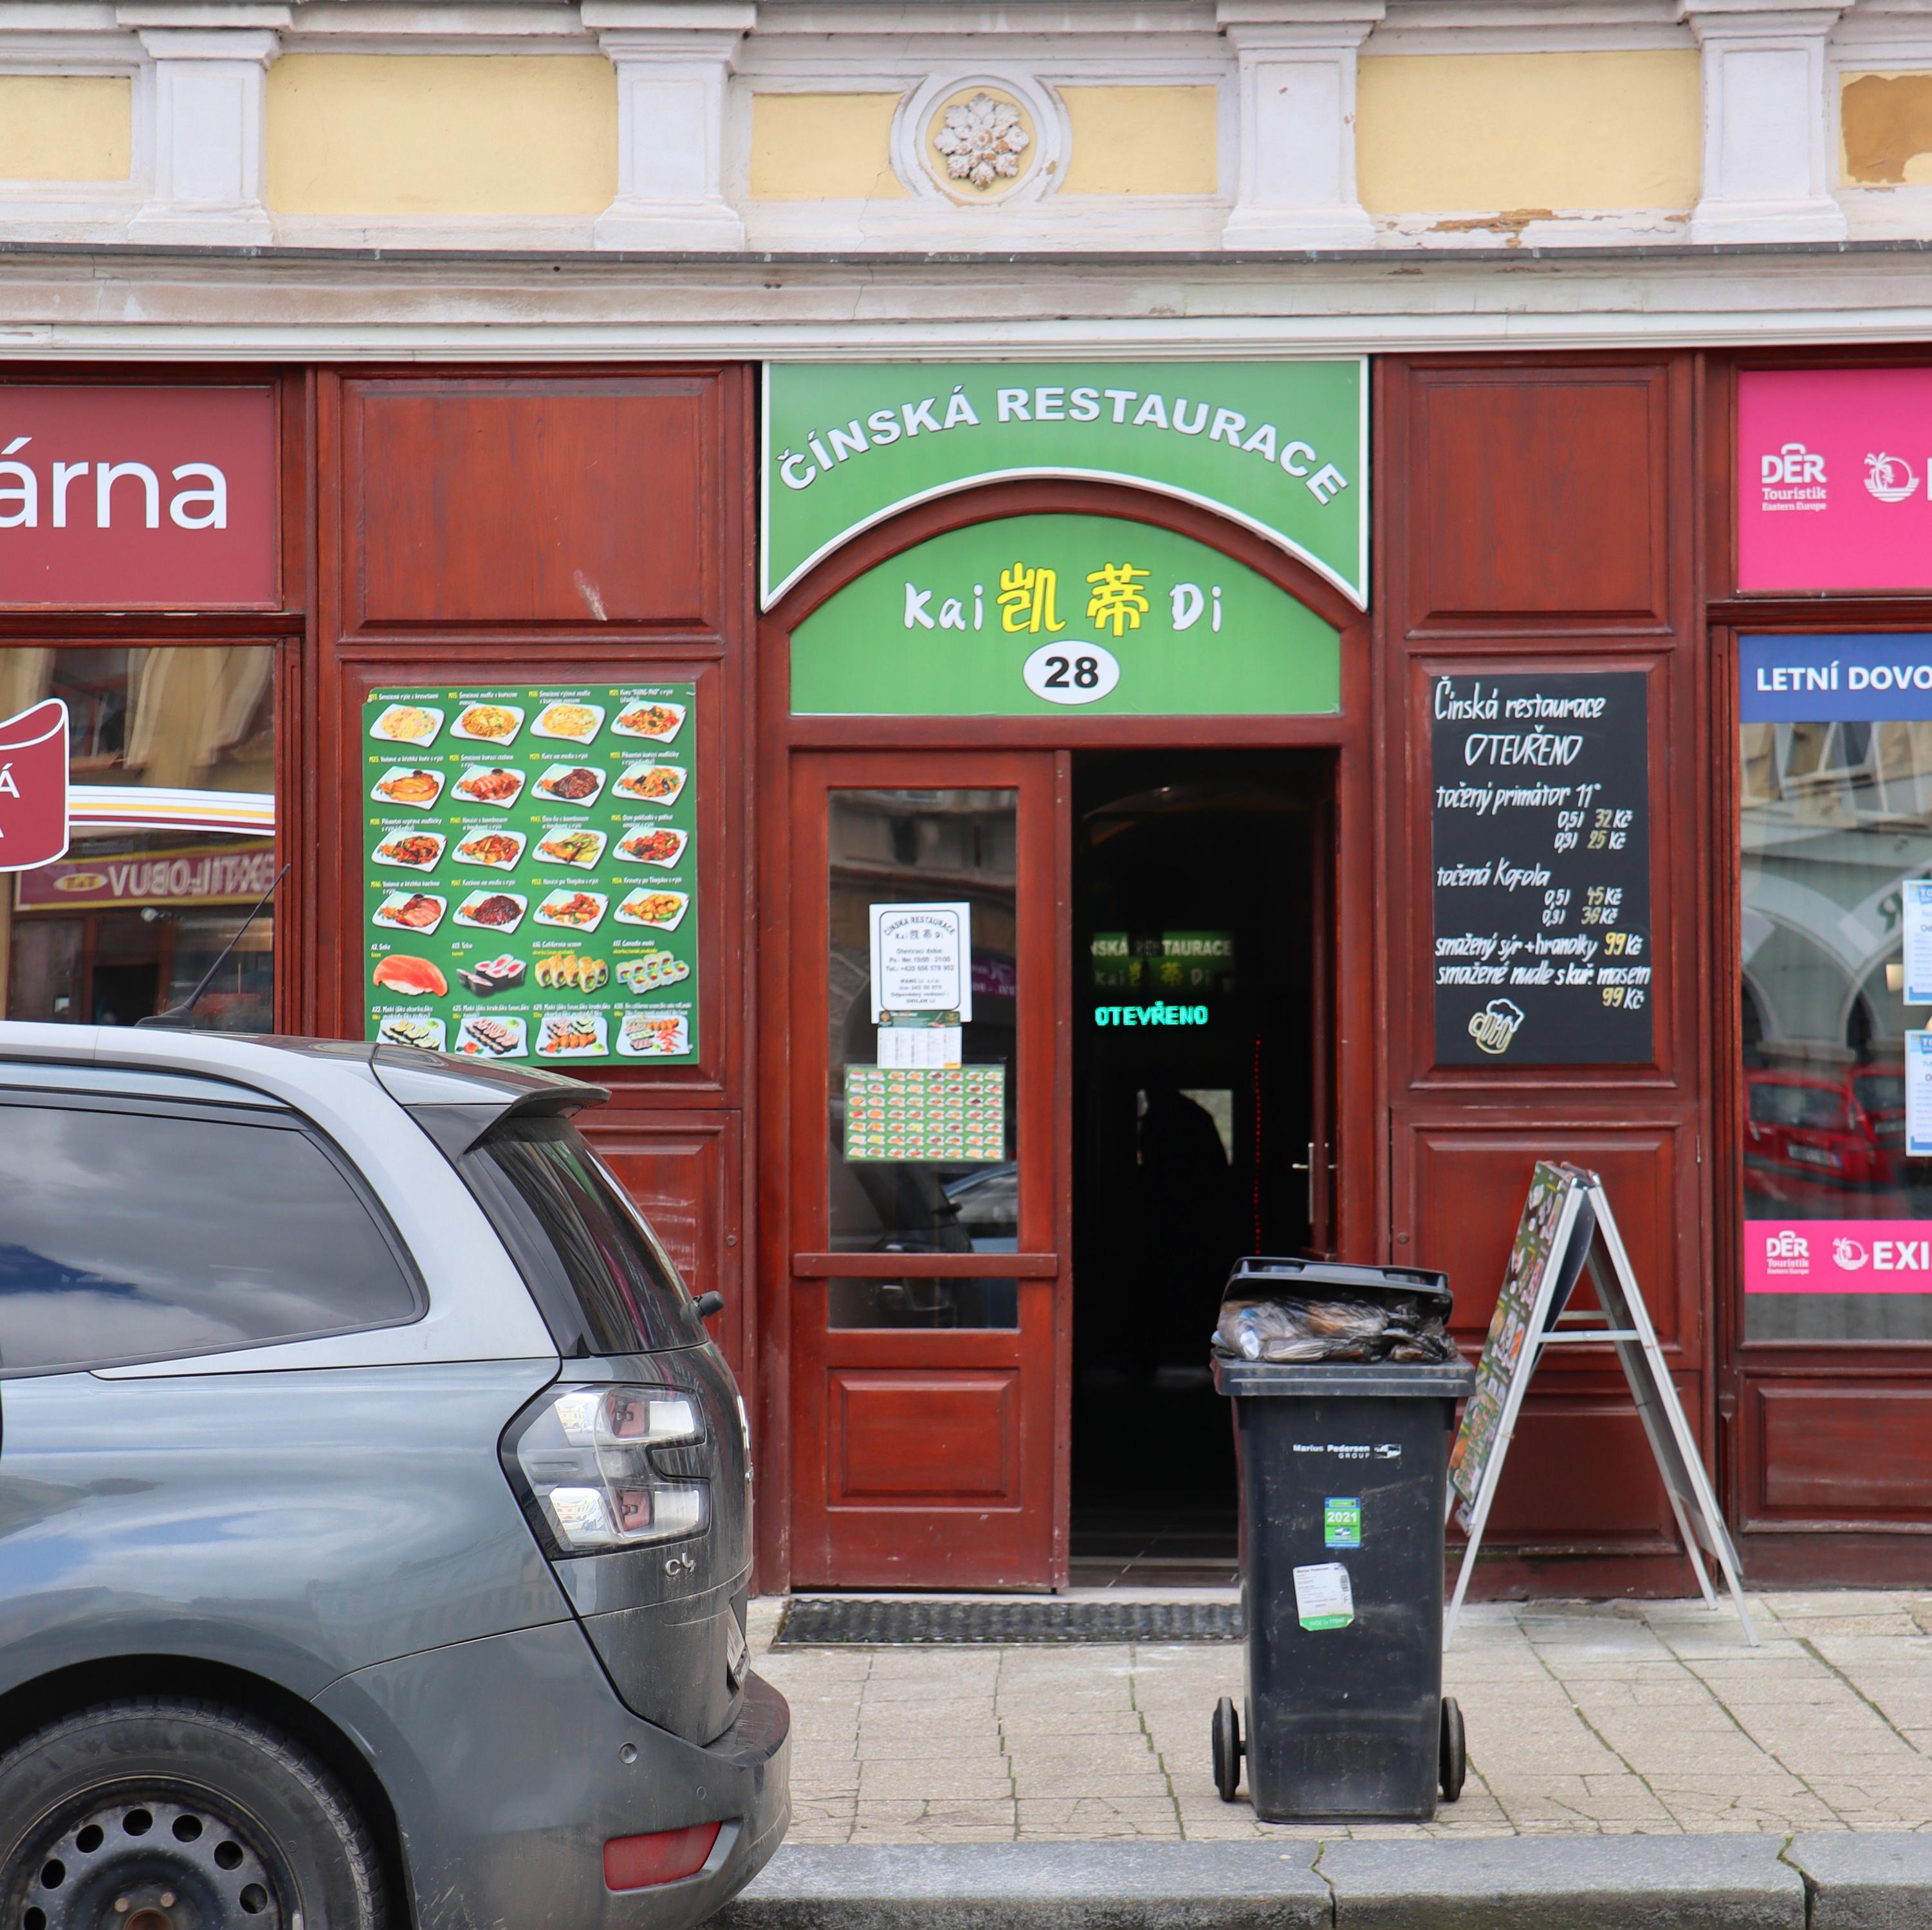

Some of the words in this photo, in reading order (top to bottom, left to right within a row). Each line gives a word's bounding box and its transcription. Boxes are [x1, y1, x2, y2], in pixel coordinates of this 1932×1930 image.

[776, 385, 980, 491] ČÍNSKÁ
[996, 387, 1349, 506] RESTAURACE
[0, 437, 227, 529] árna
[1762, 455, 1827, 484] DER
[1762, 487, 1826, 501] Touristik
[1762, 502, 1794, 511] Eastern
[1796, 502, 1826, 512] Europe
[903, 582, 984, 632] Kai
[1170, 582, 1222, 633] Di
[1044, 656, 1099, 688] 28
[1757, 659, 1839, 691] LETNÍ
[1848, 666, 1932, 690] DOVO
[1435, 676, 1498, 720] Čínská
[1505, 694, 1606, 719] restaurace
[1465, 724, 1583, 766] OTEVŘENO
[1437, 781, 1493, 816] točený
[1493, 782, 1571, 815] primátor
[1437, 861, 1493, 887] točená
[1435, 932, 1498, 961] smažený
[1498, 934, 1522, 961] sýr
[1436, 961, 1510, 985] smažené
[1510, 960, 1554, 985] nudle
[1597, 966, 1651, 985] masem
[1096, 1001, 1208, 1025] OTEVŘENO
[1766, 1238, 1809, 1257] DER
[1873, 1241, 1932, 1270] EXI
[1767, 1258, 1809, 1268] Touristik
[1327, 1444, 1370, 1452] Pedersen
[1327, 1512, 1357, 1523] 2021
[665, 1552, 696, 1577] C4
